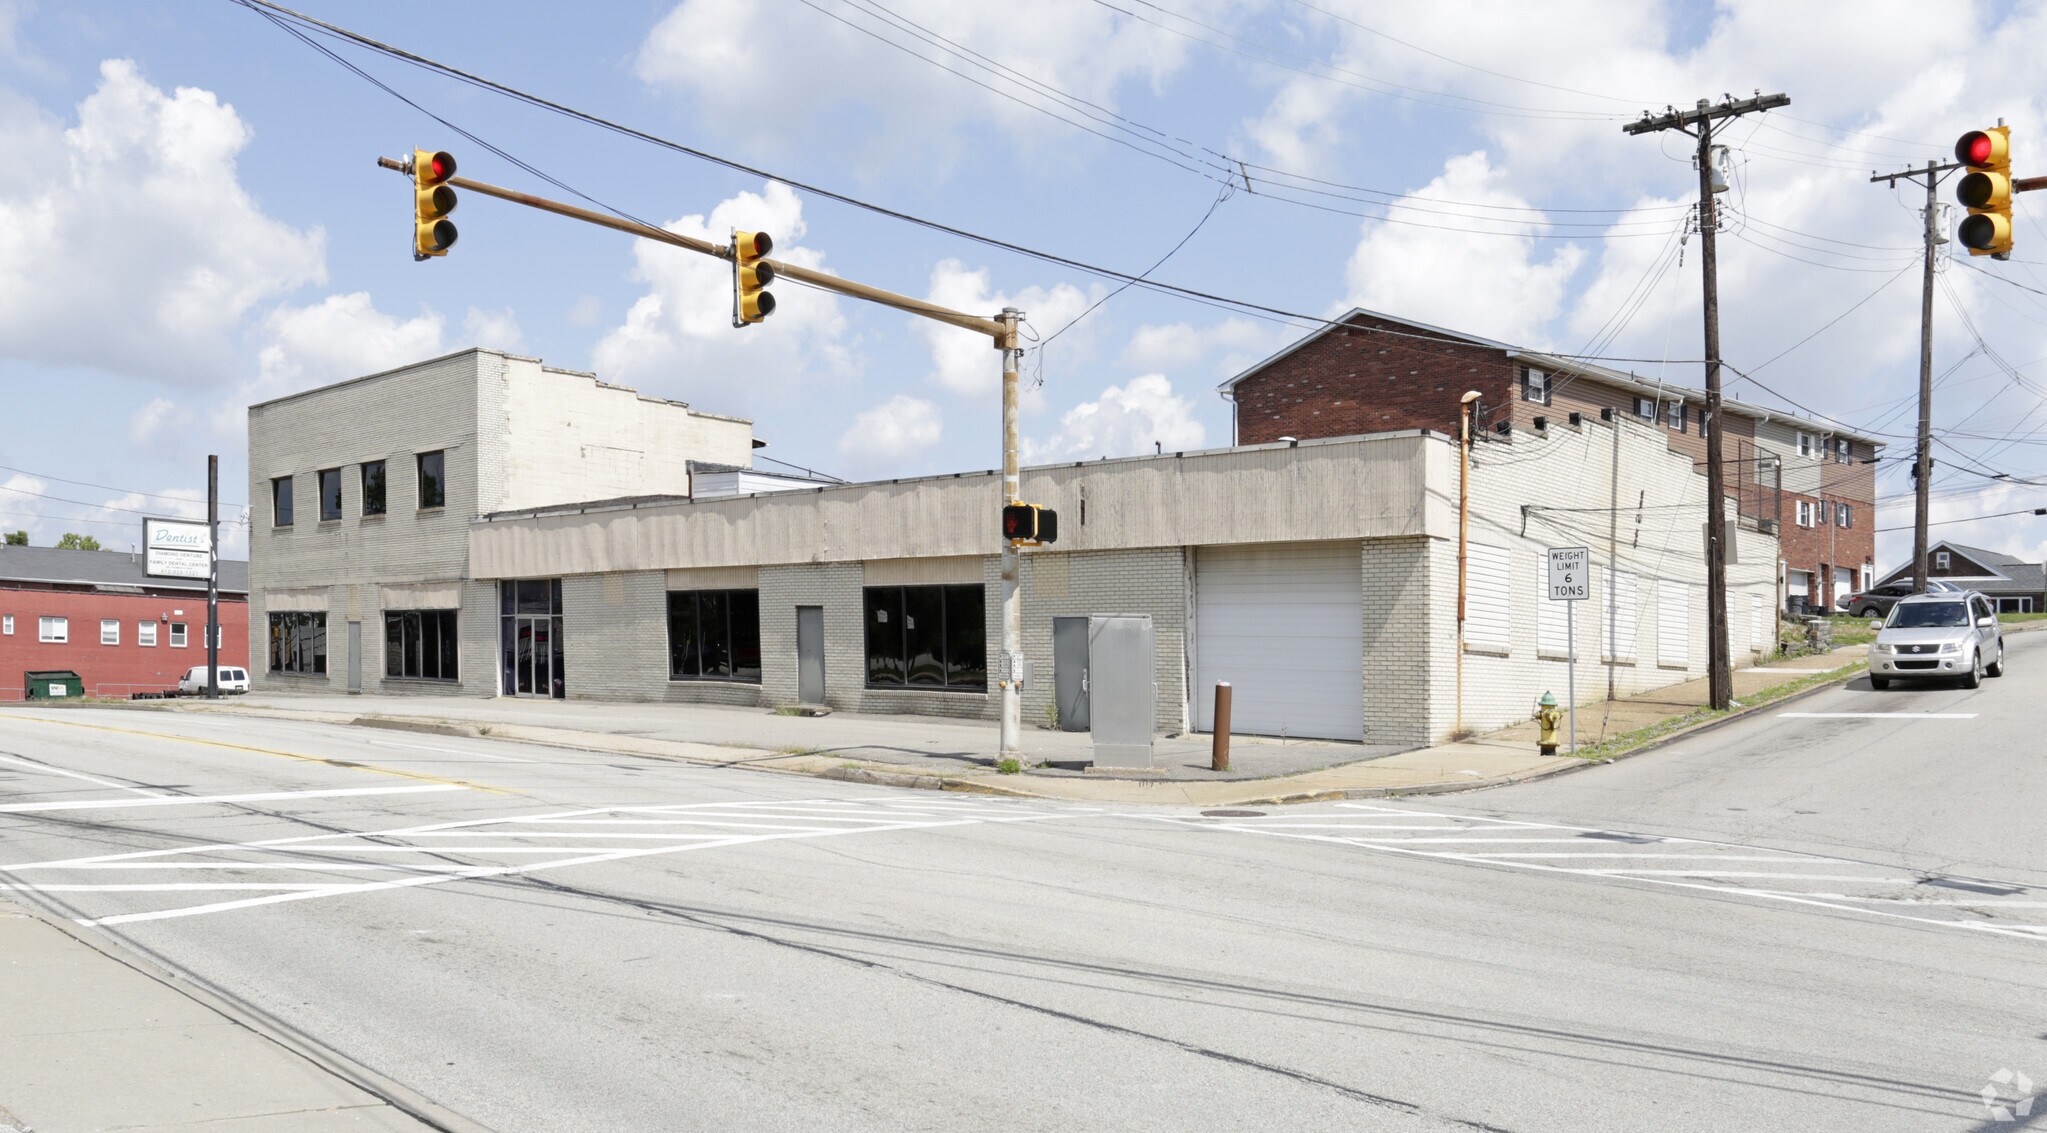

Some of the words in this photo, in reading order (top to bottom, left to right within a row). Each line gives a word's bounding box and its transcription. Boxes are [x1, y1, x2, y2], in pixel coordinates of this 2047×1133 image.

[156, 529, 198, 543] Dentist
[1552, 551, 1584, 560] WEIGHT
[1557, 562, 1579, 570] LIMIT
[1565, 573, 1572, 583] 6
[1554, 586, 1583, 595] TONS
